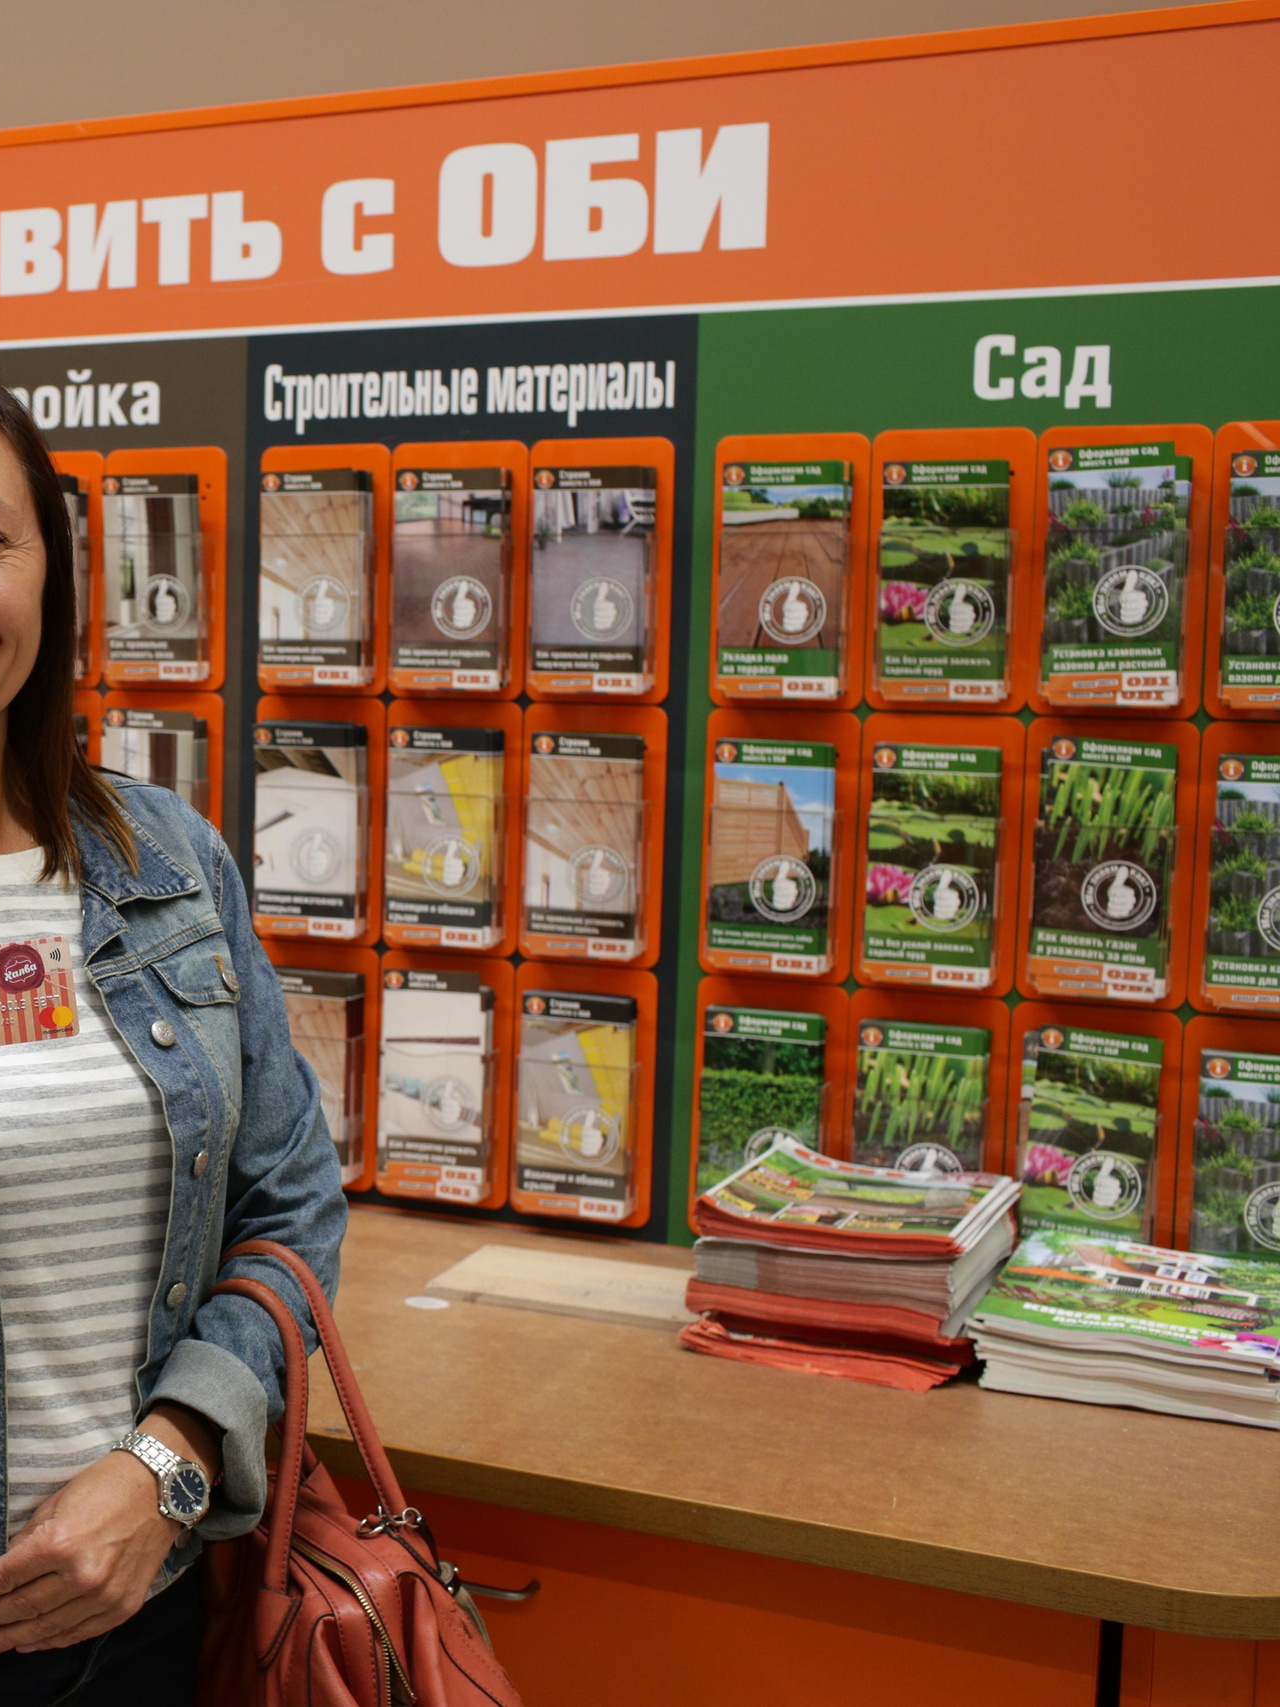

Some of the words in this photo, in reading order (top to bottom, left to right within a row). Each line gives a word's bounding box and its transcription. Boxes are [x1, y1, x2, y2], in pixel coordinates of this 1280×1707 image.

[321, 178, 395, 275] с
[438, 122, 769, 268] ОБИ
[972, 333, 1112, 409] Сад
[10, 368, 161, 430] ойка
[264, 363, 478, 435] Строительные
[486, 360, 676, 427] материалы
[1078, 447, 1139, 459] Оформляем
[1141, 446, 1160, 456] сад
[1079, 459, 1106, 468] вместе
[1114, 457, 1130, 465] ОБИ
[749, 465, 804, 475] Оформляем
[805, 466, 822, 476] сад
[911, 464, 969, 474] Оформляем
[970, 465, 987, 474] сад
[722, 652, 763, 663] Укладка
[764, 653, 789, 663] пола
[1053, 648, 1105, 659] Установка
[1107, 647, 1163, 658] каменных
[722, 665, 735, 673] на
[736, 665, 776, 676] террасе
[1053, 660, 1095, 671] вазонов
[1097, 661, 1117, 671] для
[1118, 658, 1167, 670] растений
[1228, 658, 1280, 672] Установк
[1127, 676, 1169, 687] OBI
[1228, 673, 1273, 684] вазонов
[787, 682, 824, 691] OBI
[954, 685, 993, 695] OBI
[902, 749, 958, 761] Оформляем
[960, 753, 977, 763] сад
[1082, 741, 1142, 756] Оформляем
[1144, 748, 1162, 759] сад
[1082, 753, 1109, 761] вместе
[1116, 754, 1132, 763] ОБИ
[869, 937, 884, 946] Как
[886, 938, 900, 948] без
[902, 940, 931, 950] усилий
[933, 943, 975, 953] заложить
[1037, 931, 1057, 942] Как
[1060, 935, 1104, 948] посеять
[1105, 939, 1138, 951] газон
[868, 948, 904, 958] садовый
[906, 951, 926, 961] пруд
[1036, 944, 1044, 953] и
[1045, 945, 1105, 960] ухаживать
[1107, 952, 1120, 961] за
[1122, 953, 1146, 965] ним
[776, 959, 813, 969] OBI
[1212, 960, 1267, 971] Установка
[4, 963, 37, 981] Халва
[936, 971, 975, 981] OBI
[1107, 969, 1148, 981] OBI
[1211, 974, 1256, 985] вазонов
[1258, 977, 1278, 986] для
[42, 1026, 74, 1035] mastercard
[888, 1029, 944, 1043] Оформляем
[945, 1035, 962, 1047] сад
[1070, 1032, 1130, 1049] Оформляем
[1131, 1040, 1149, 1053] сад
[1069, 1043, 1096, 1052] вместе
[1103, 1046, 1119, 1056] ОБИ
[1237, 1071, 1266, 1080] вместе
